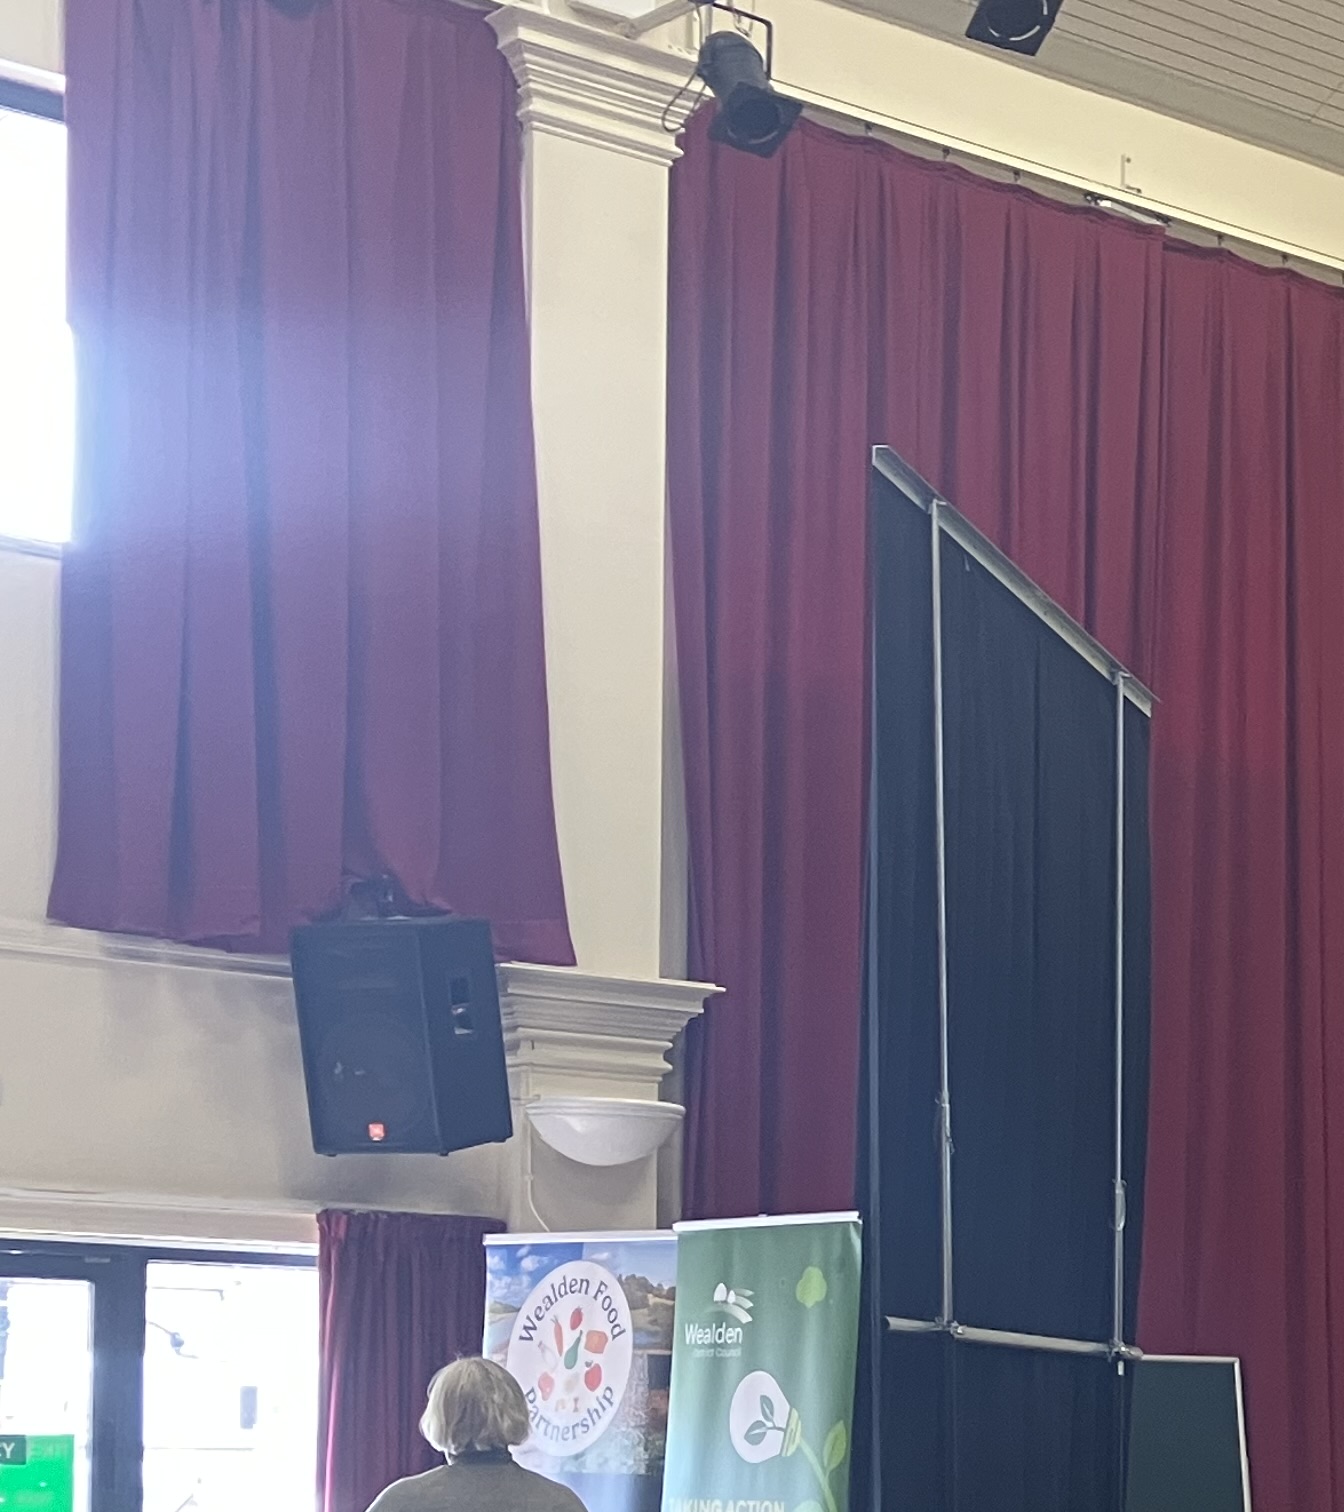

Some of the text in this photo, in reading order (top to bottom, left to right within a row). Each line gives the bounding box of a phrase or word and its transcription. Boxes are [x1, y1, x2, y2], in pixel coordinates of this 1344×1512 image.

[518, 1274, 627, 1342] Wealden Food
[684, 1321, 743, 1345] Wealden
[523, 1385, 615, 1444] Partnership
